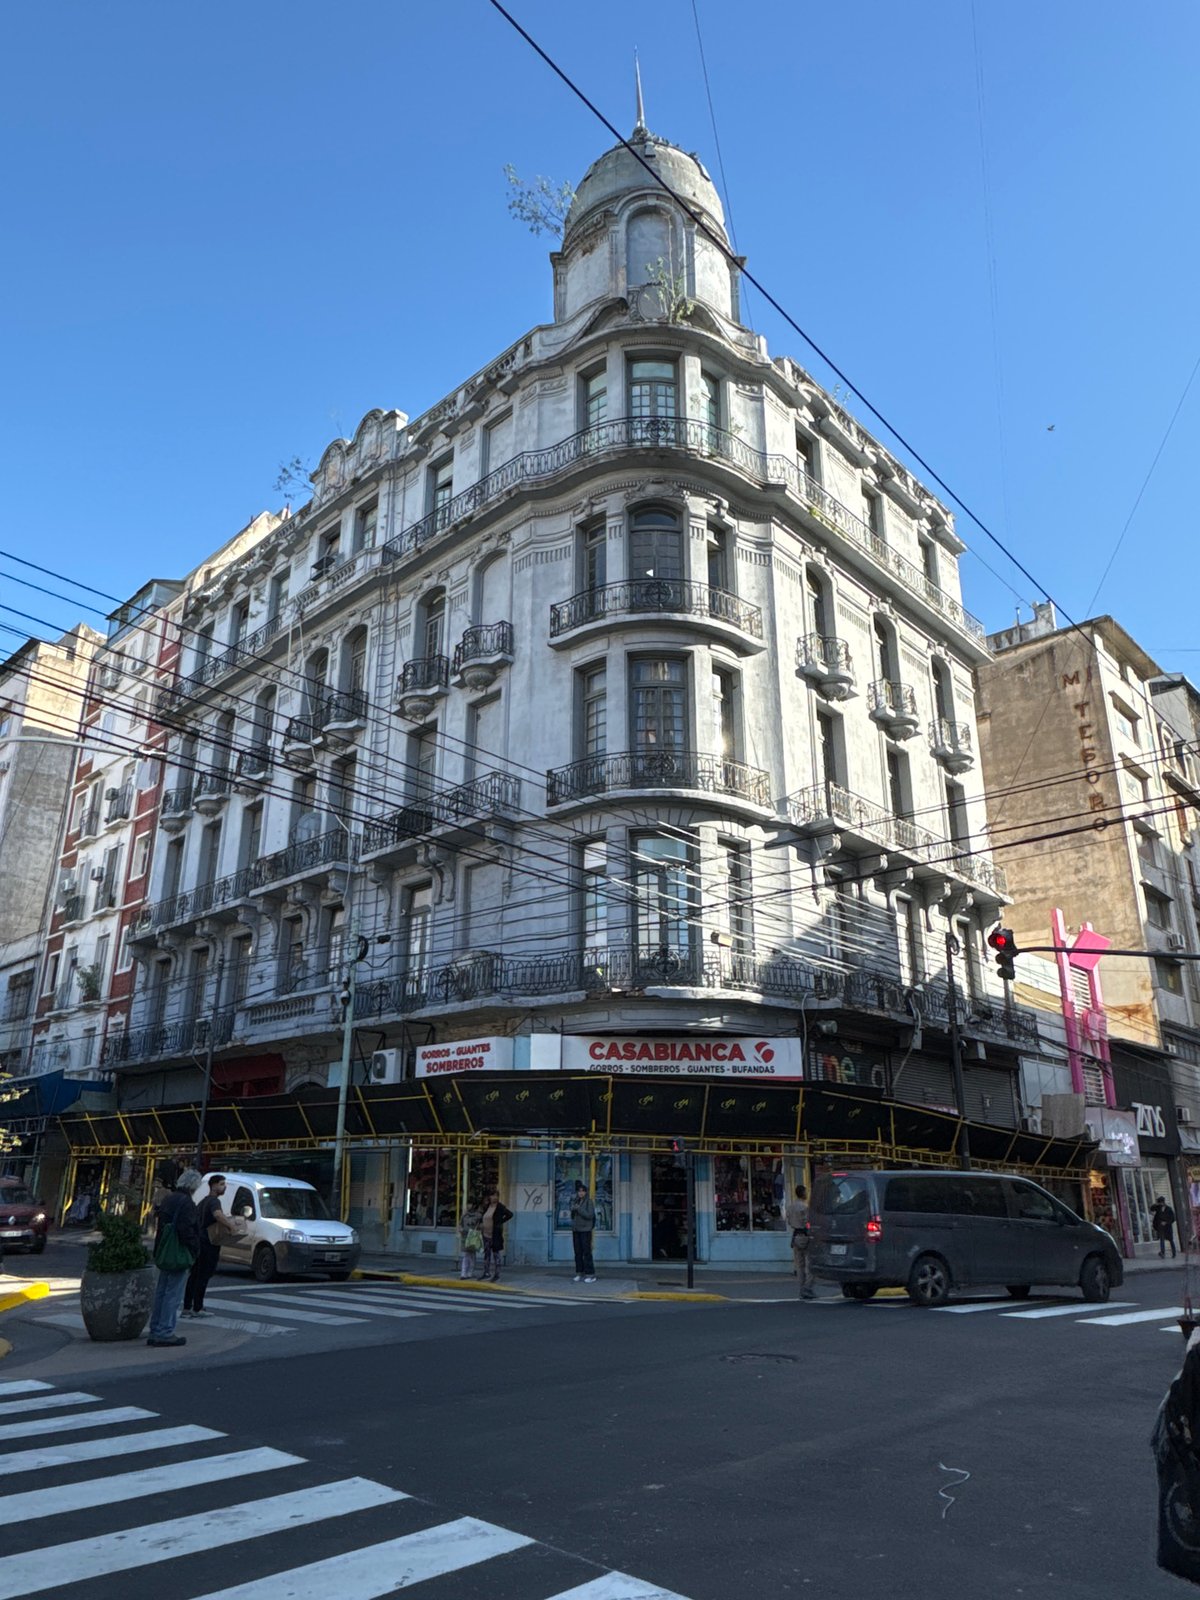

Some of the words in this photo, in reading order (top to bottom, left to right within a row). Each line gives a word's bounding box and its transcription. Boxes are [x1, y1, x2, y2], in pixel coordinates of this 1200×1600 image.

[1062, 665, 1093, 688] MI
[1074, 701, 1108, 832] TESORO
[421, 1048, 451, 1060] GORROS
[456, 1043, 491, 1056] GUANTES
[589, 1042, 746, 1061] CASABIANCA
[426, 1056, 484, 1073] SOMBREROS
[590, 1064, 623, 1073] GORROS
[630, 1065, 680, 1073] SOMBREROS
[687, 1065, 725, 1074] GUANTES
[732, 1065, 775, 1074] BUFANDAS
